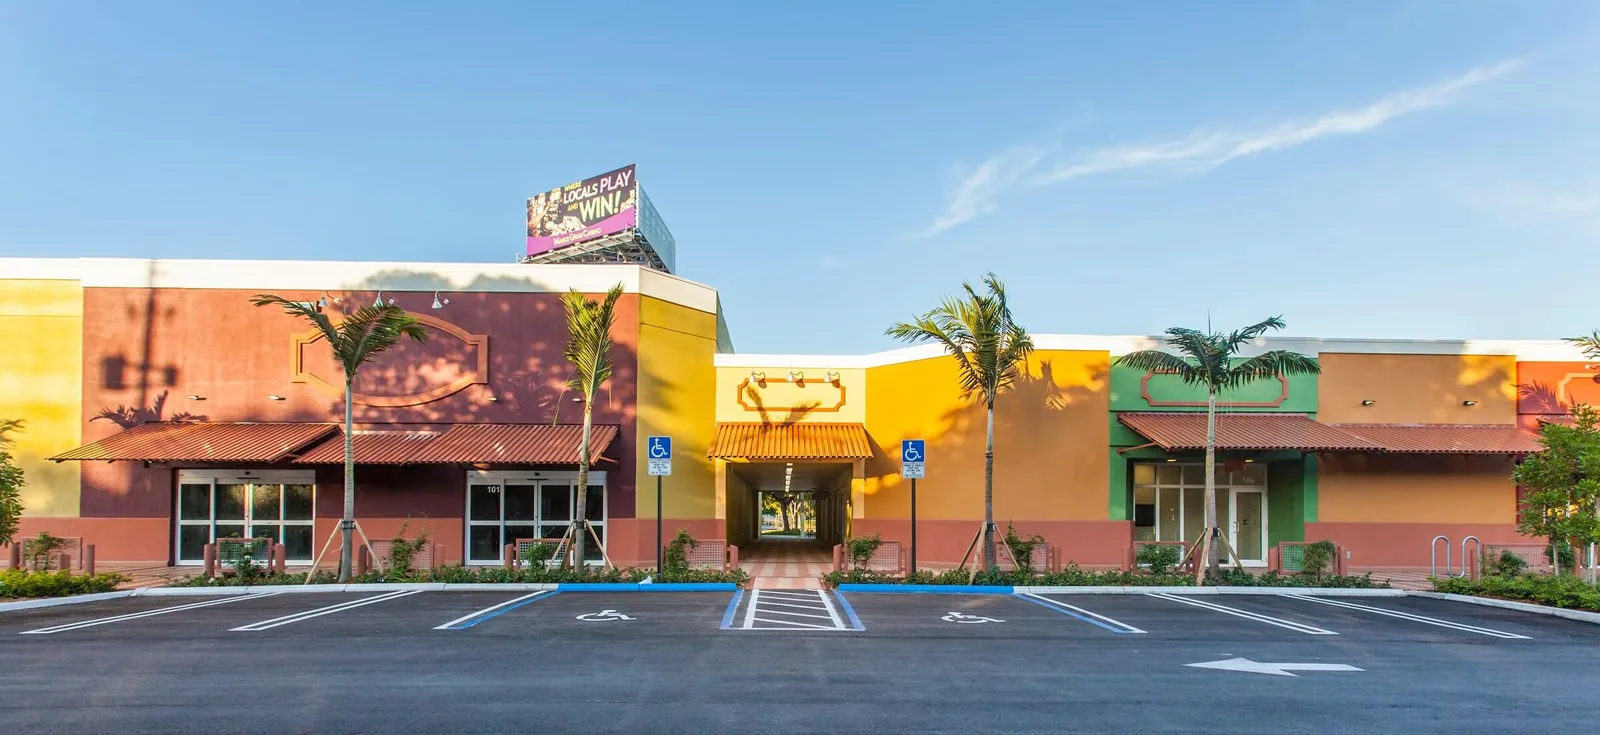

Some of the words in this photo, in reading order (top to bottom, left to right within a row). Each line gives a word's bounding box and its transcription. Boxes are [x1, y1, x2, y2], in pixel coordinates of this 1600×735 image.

[563, 183, 598, 205] LOCALS
[600, 170, 633, 193] PLAY
[564, 181, 582, 192] WHERE
[567, 203, 578, 212] AND
[579, 190, 622, 223] WIN!
[487, 485, 500, 494] 101
